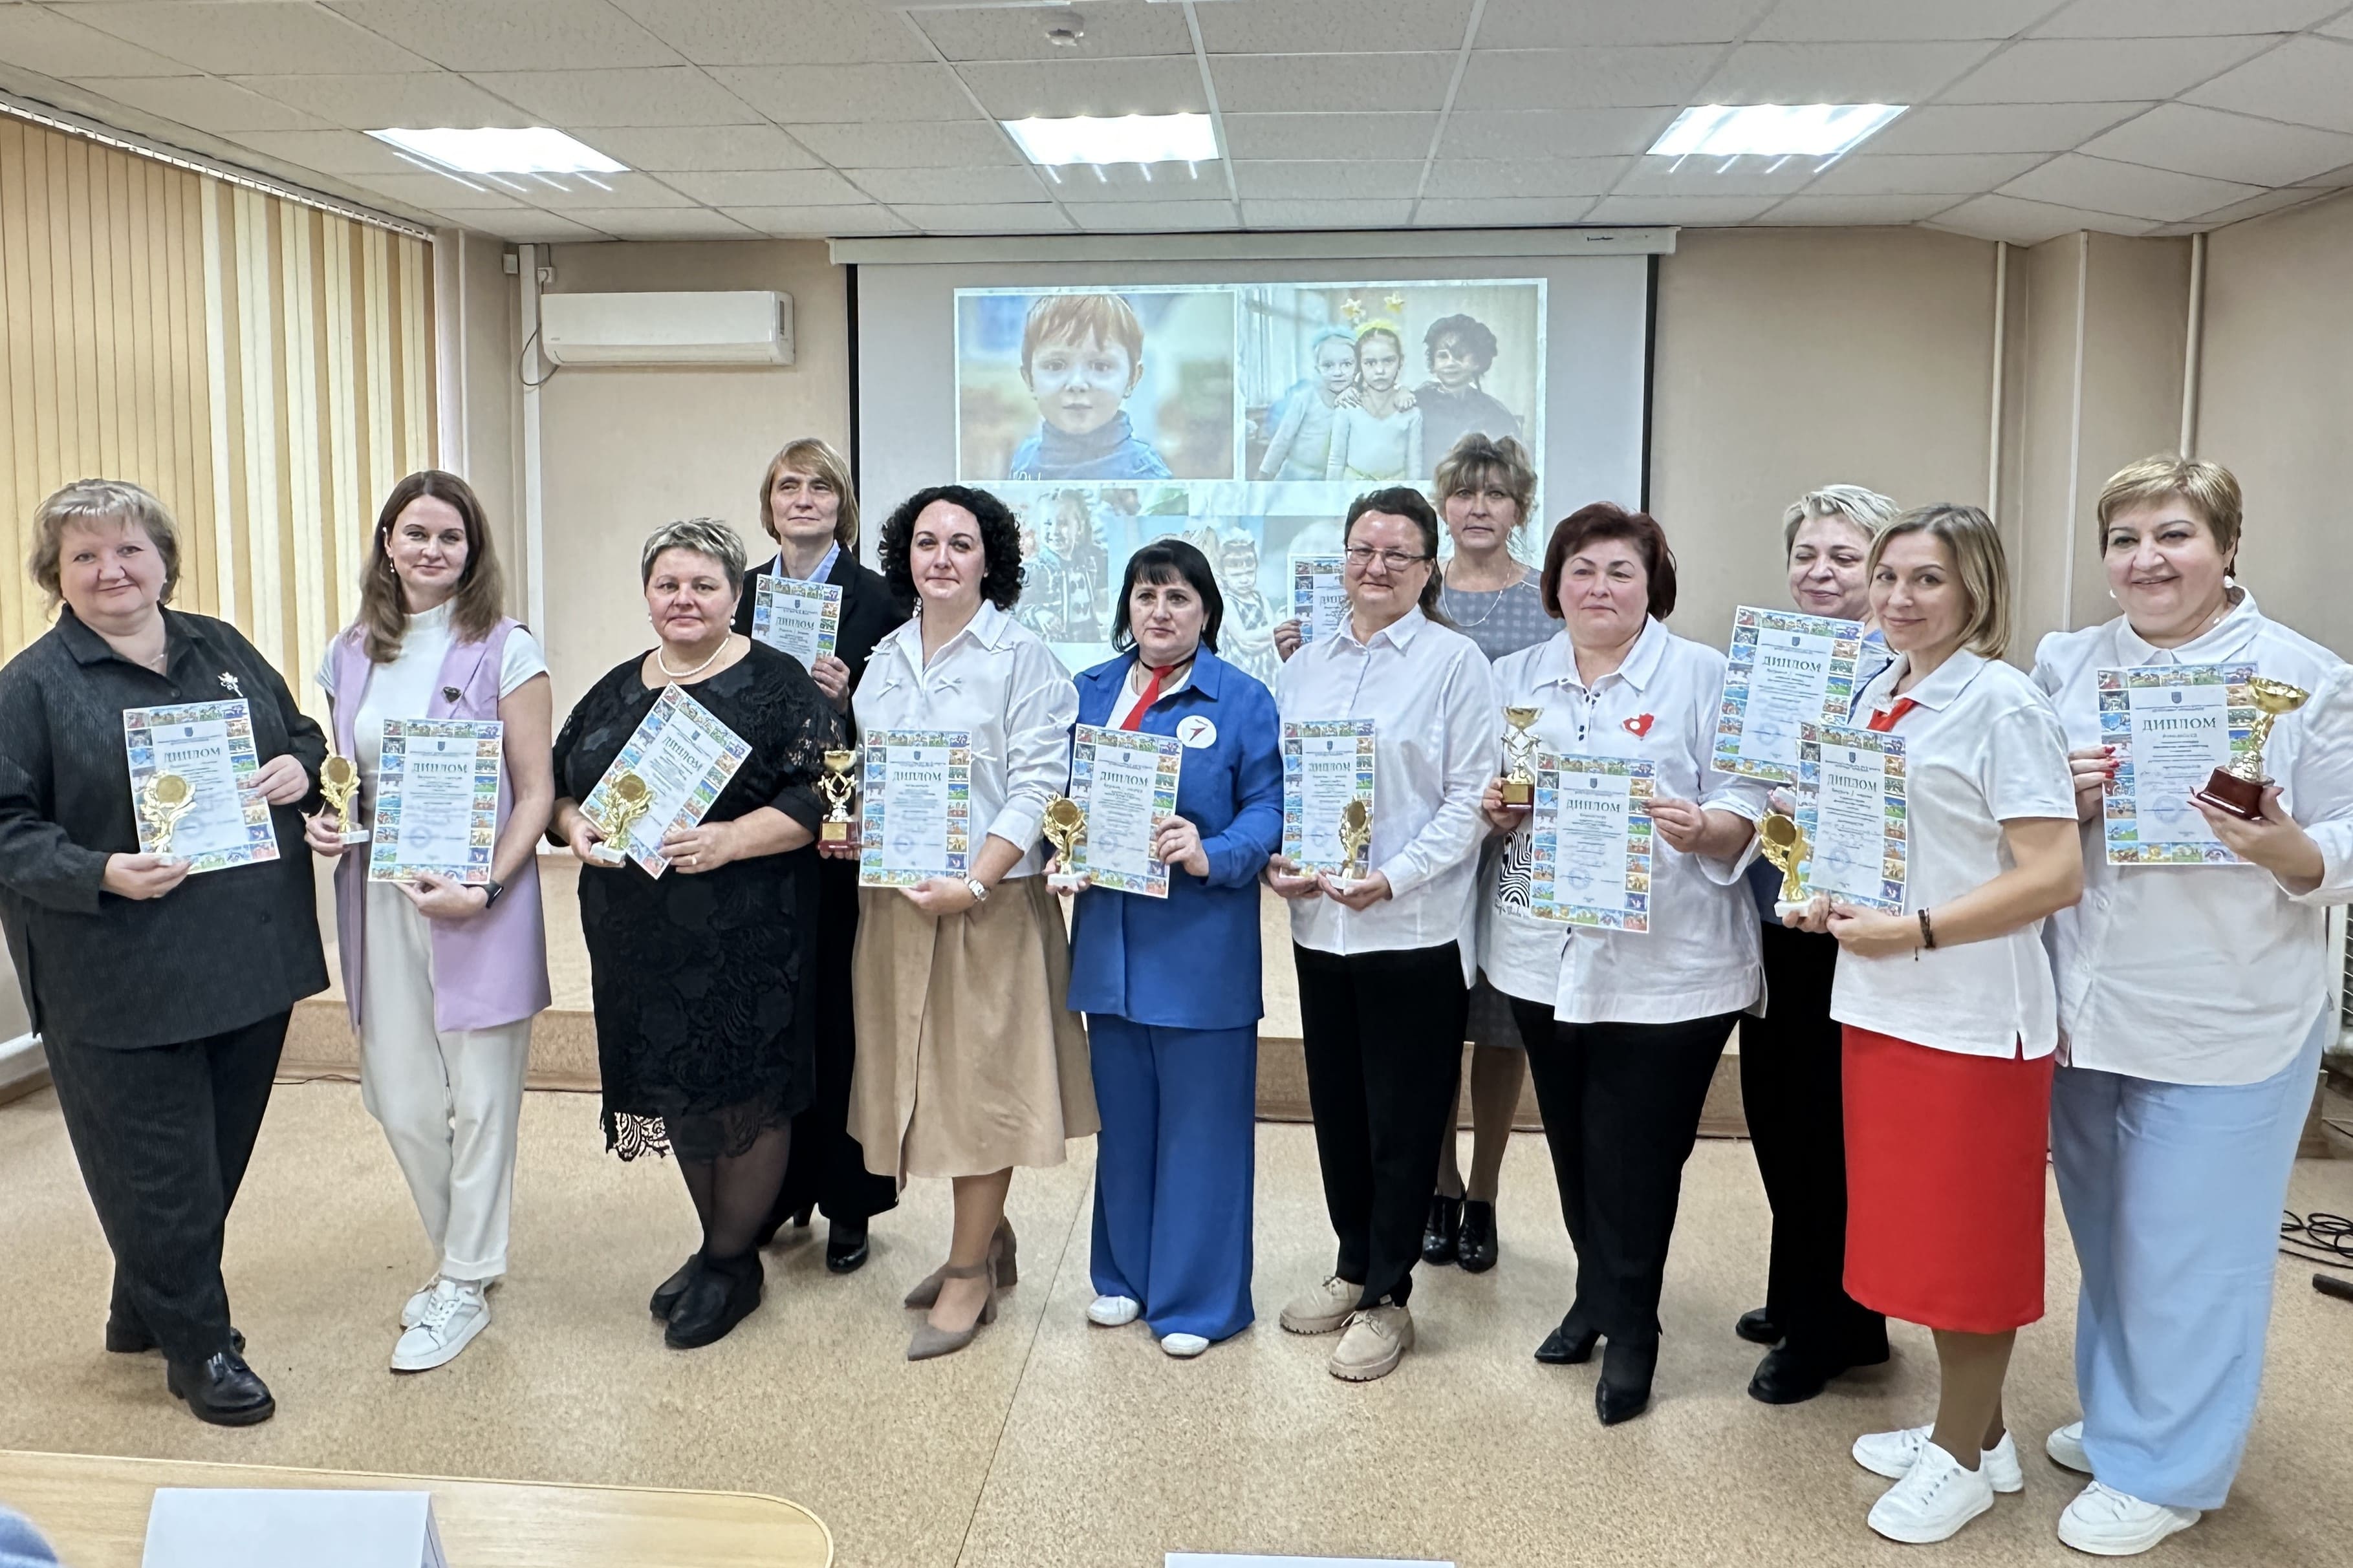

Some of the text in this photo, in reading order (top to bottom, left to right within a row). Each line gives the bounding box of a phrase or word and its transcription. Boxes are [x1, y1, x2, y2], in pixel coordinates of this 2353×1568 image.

[1762, 656, 1822, 672] ДИПЛОМ
[2142, 717, 2217, 731] ДИПЛОМ
[1100, 771, 1149, 787] ДИПЛОМ
[1827, 773, 1878, 793] ДИПЛОМ
[1566, 799, 1621, 813] ДИПЛОМ
